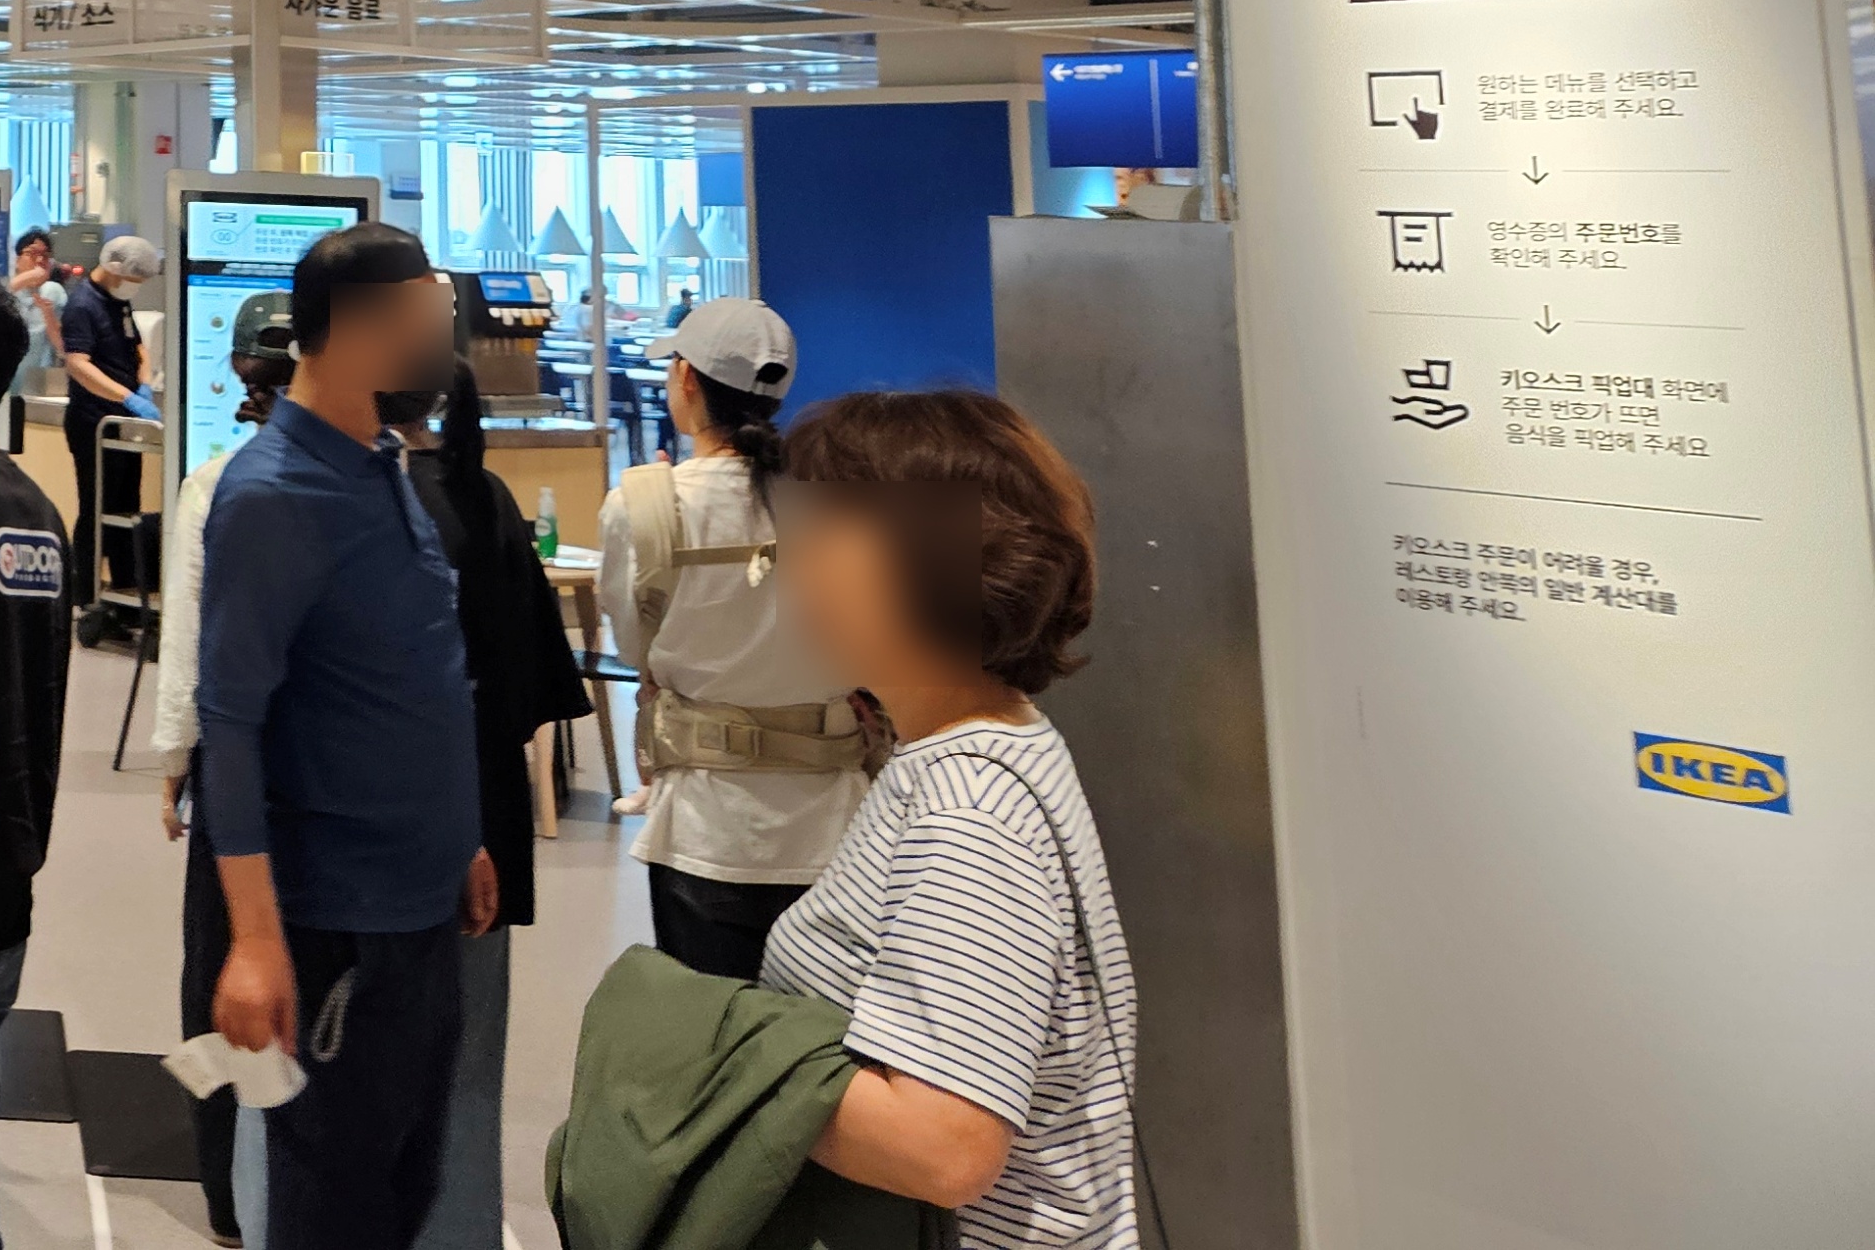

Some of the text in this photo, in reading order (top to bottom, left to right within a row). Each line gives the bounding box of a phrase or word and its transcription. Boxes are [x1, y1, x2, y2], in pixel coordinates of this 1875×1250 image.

[81, 2, 115, 26] 소스
[1478, 69, 1700, 95] 원하는 메뉴를 선택하고
[1478, 100, 1537, 121] 결제를
[1545, 99, 1607, 120] 완료해
[1487, 221, 1682, 244] 영수증의 주문번호를
[1489, 248, 1551, 268] 확인해
[1500, 369, 1729, 403] 키오스크 픽업대 화면에
[1501, 396, 1660, 427] 주문 번호가 뜨면
[1506, 423, 1566, 448] 음식을
[1574, 429, 1636, 452] 픽업해
[1394, 534, 1471, 560] 키오스크
[1477, 543, 1537, 569] 주문이
[1542, 551, 1605, 578] 어려울
[1395, 561, 1678, 616] 레스토랑 안쪽의 일반 계산대를
[1395, 588, 1454, 614] 이용해
[1649, 752, 1776, 793] IKEA
